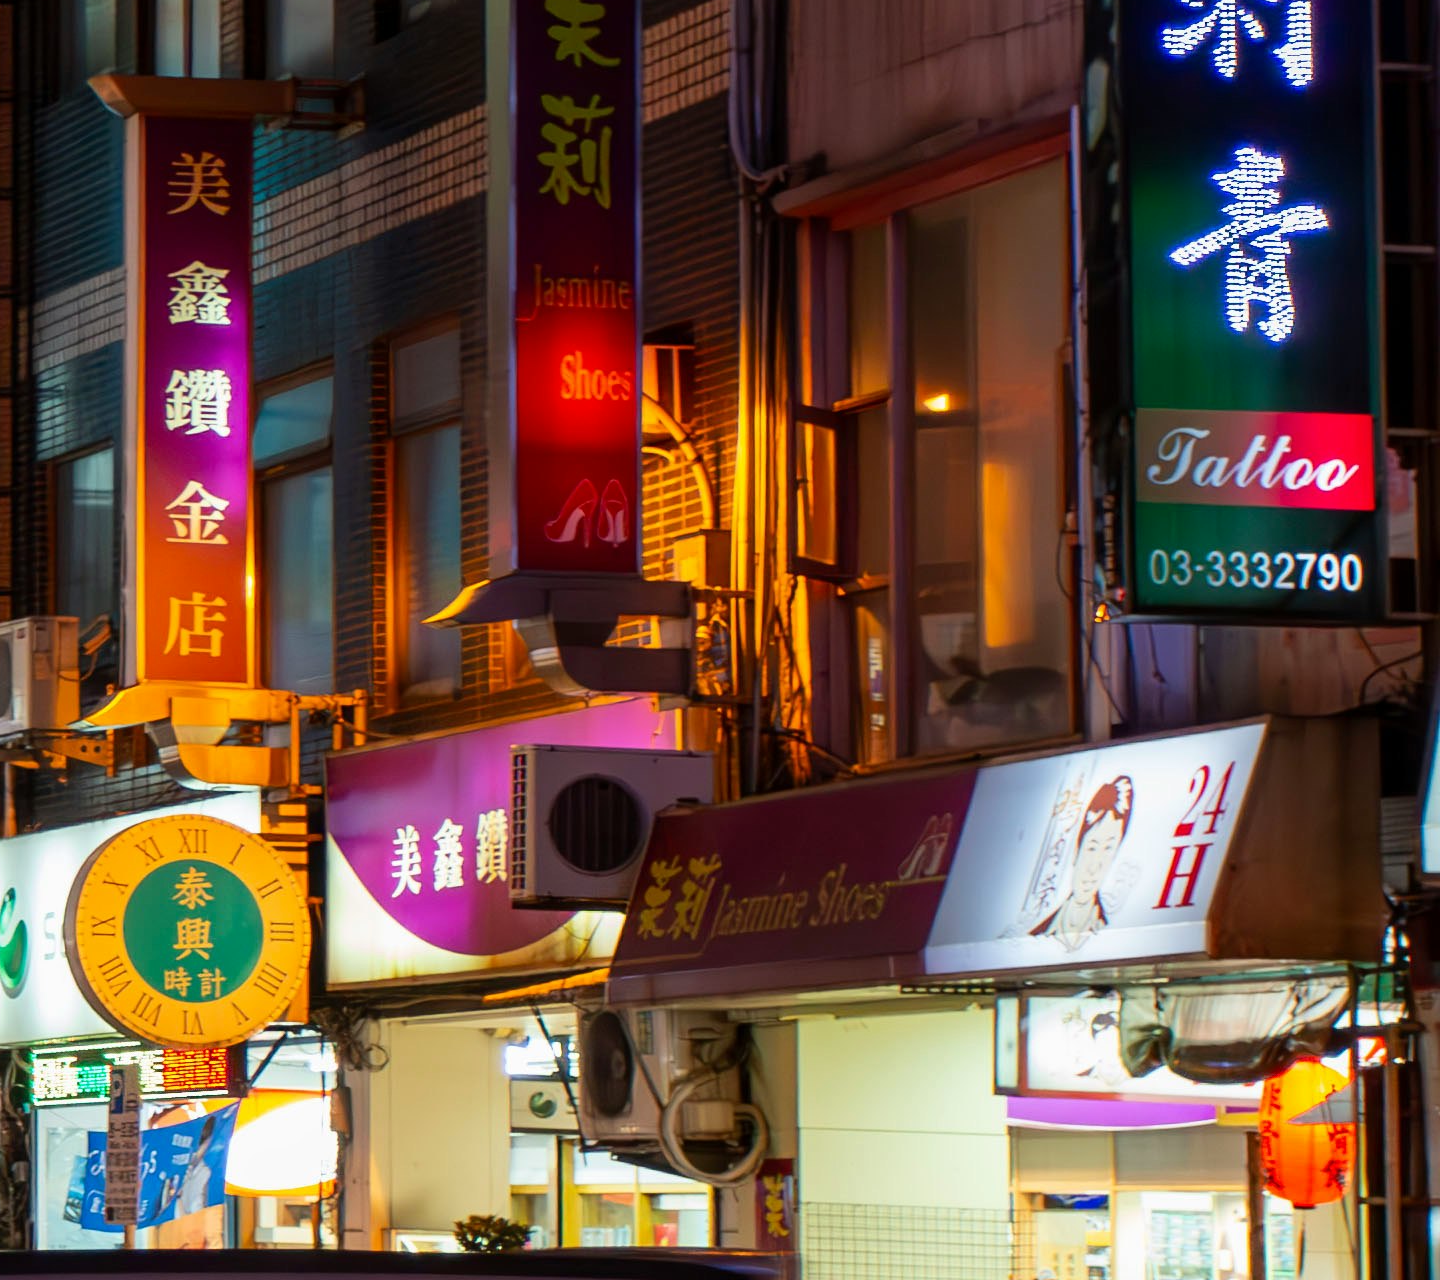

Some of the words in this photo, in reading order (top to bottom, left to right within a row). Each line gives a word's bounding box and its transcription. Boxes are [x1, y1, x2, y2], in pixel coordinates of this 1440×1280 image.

[526, 263, 631, 318] Jasmine
[162, 152, 234, 658] 美鑫鑽金店
[559, 349, 632, 403] Shoes
[1146, 426, 1361, 494] Tattoo
[1149, 548, 1364, 594] 03-3332790
[1172, 760, 1236, 838] 24
[706, 870, 808, 944] Jasmine
[809, 861, 888, 930] Shoes
[1152, 842, 1215, 910] H
[171, 865, 216, 962] 泰興
[163, 968, 228, 1000] 時計
